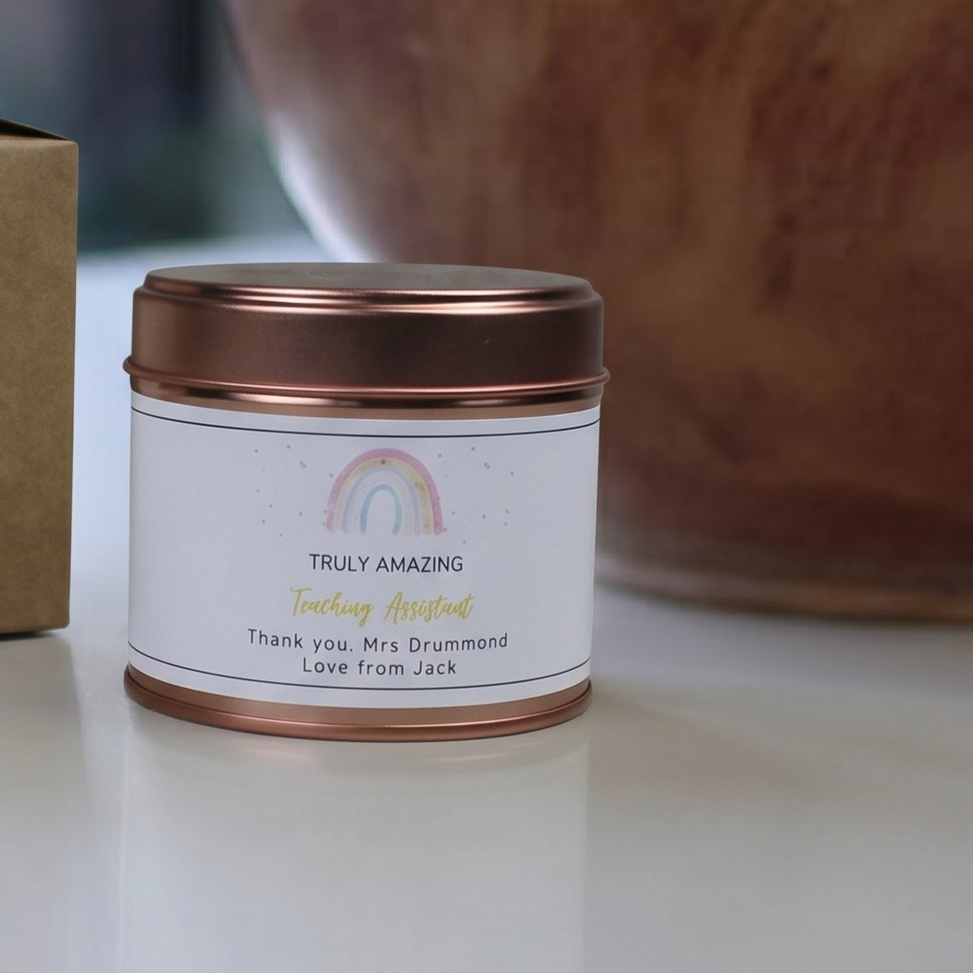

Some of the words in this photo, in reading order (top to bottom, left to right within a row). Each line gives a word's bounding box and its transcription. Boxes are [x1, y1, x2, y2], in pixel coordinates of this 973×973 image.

[309, 553, 370, 572] TRULY
[376, 556, 463, 573] AMAZING
[290, 587, 375, 627] Teaching
[383, 591, 475, 625] Assistant
[247, 628, 303, 649] Thank
[363, 637, 399, 652] Mrs
[409, 633, 508, 653] Drummond
[303, 657, 348, 675] Love
[358, 659, 404, 675] from
[413, 659, 457, 675] Jack
